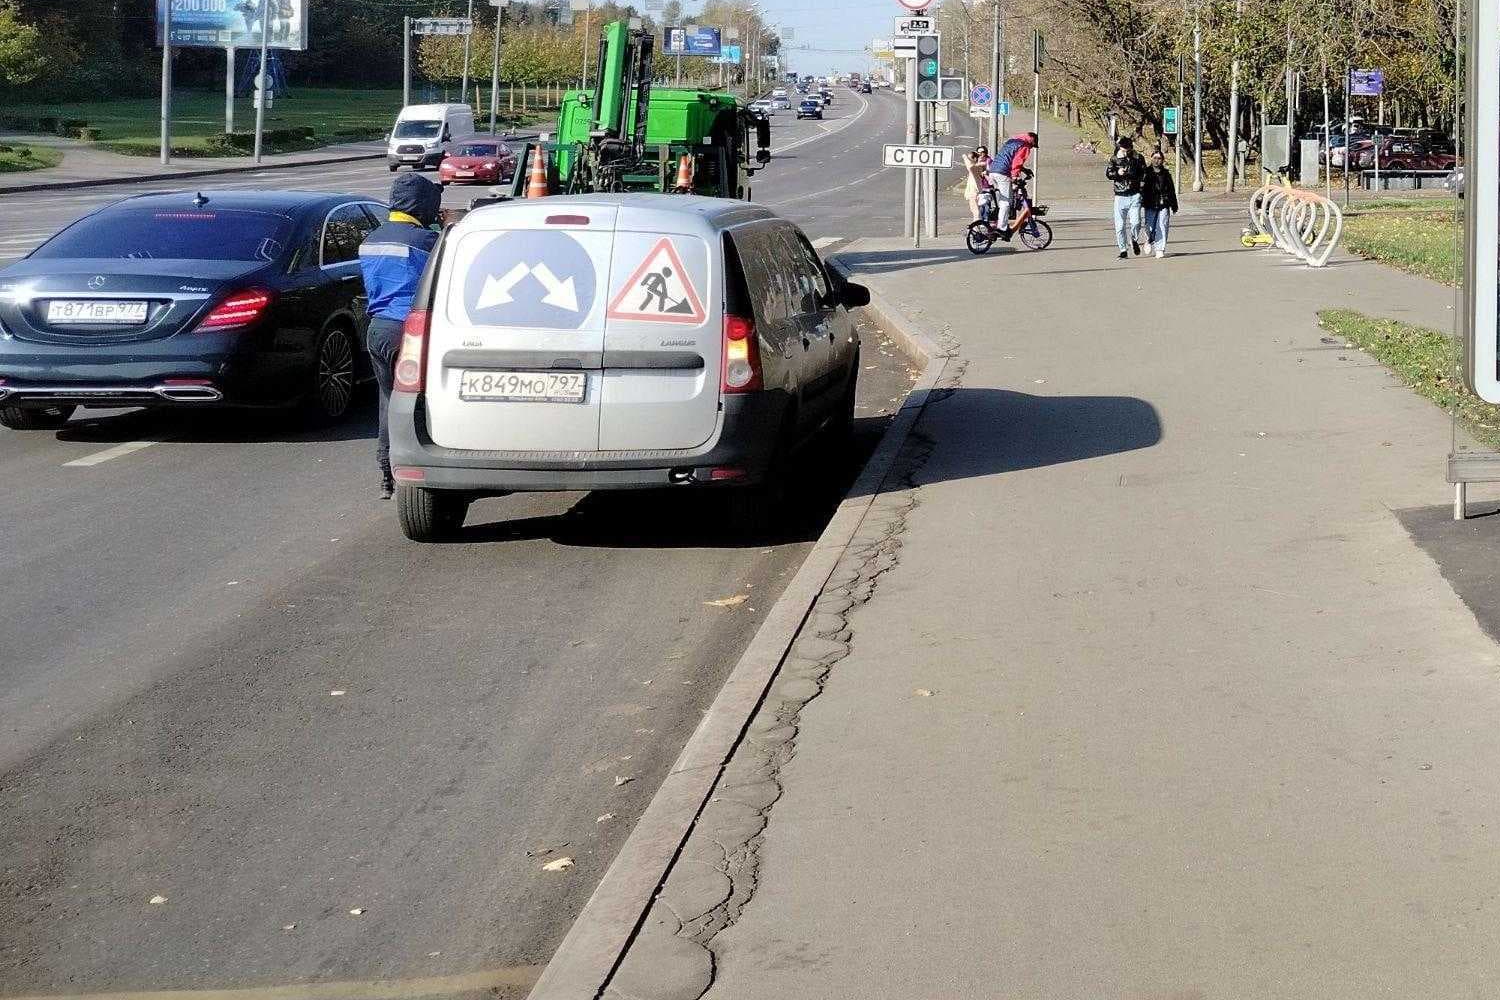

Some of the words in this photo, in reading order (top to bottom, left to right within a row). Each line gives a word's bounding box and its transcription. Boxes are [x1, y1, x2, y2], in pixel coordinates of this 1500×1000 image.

[893, 149, 944, 164] СТОП
[119, 302, 143, 314] 977
[468, 375, 546, 394] К849МО
[550, 375, 579, 390] 797
